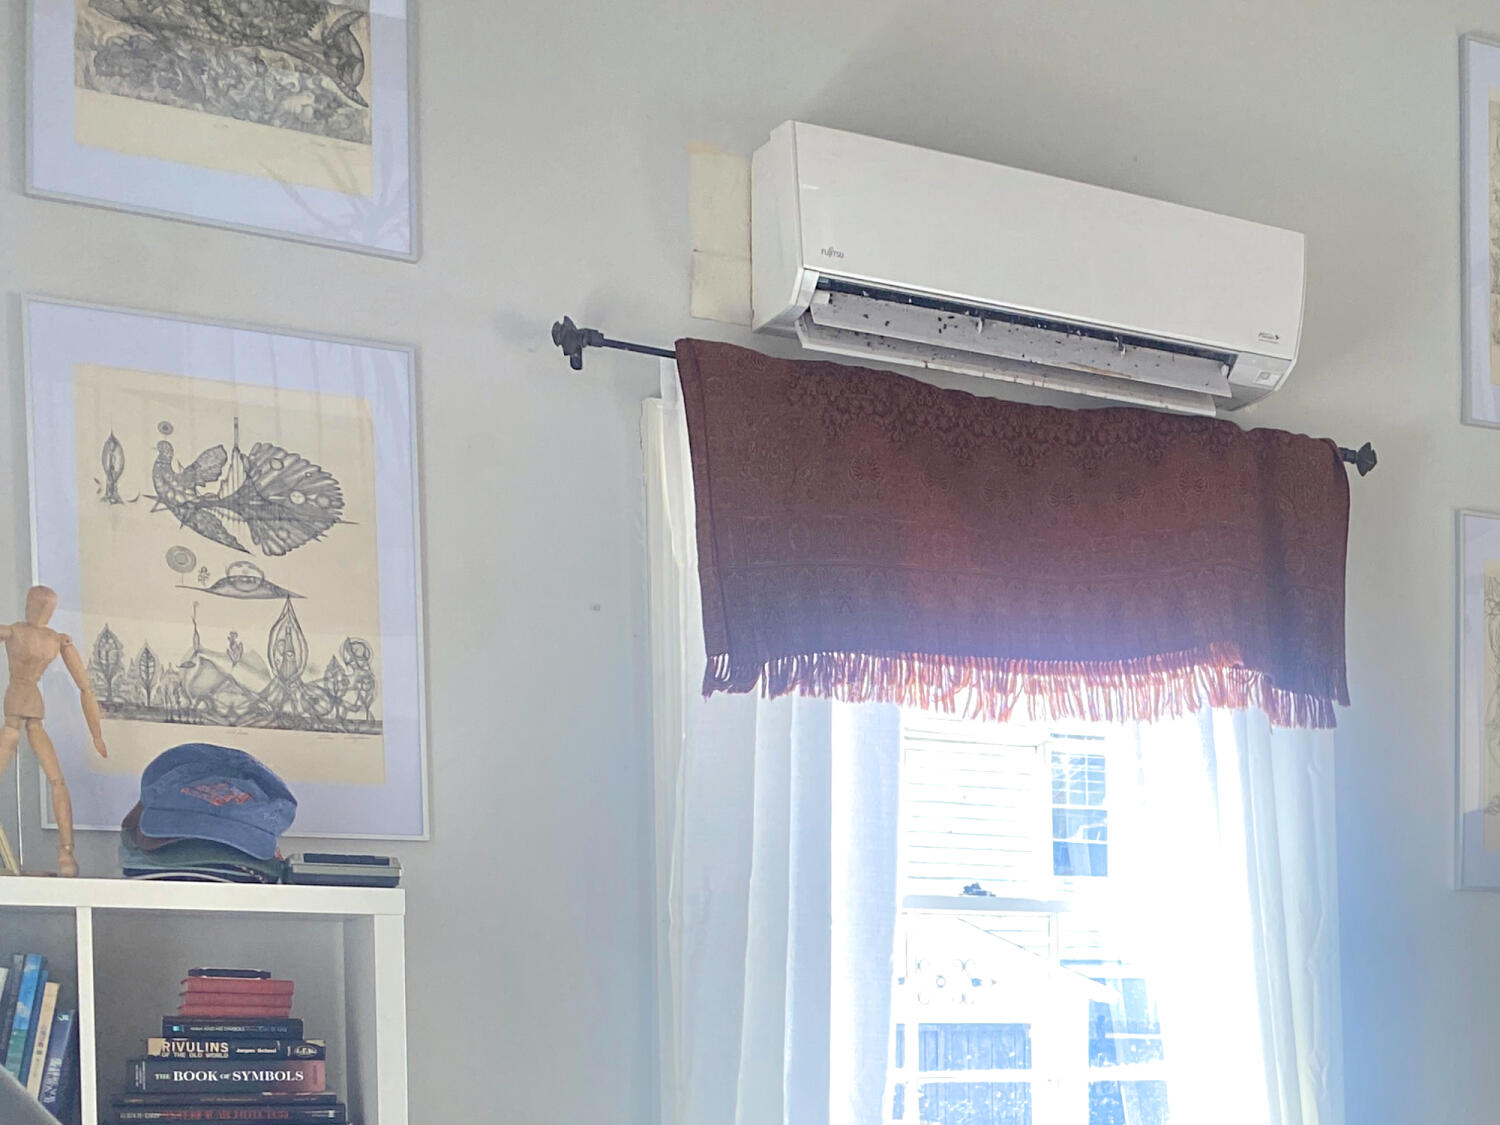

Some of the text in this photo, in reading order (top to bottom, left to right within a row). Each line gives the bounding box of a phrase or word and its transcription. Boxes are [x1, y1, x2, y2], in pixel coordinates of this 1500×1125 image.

[161, 1041, 229, 1053] RIVULINS
[173, 1070, 218, 1082] BOOK
[232, 1070, 304, 1082] SYMBOLS
